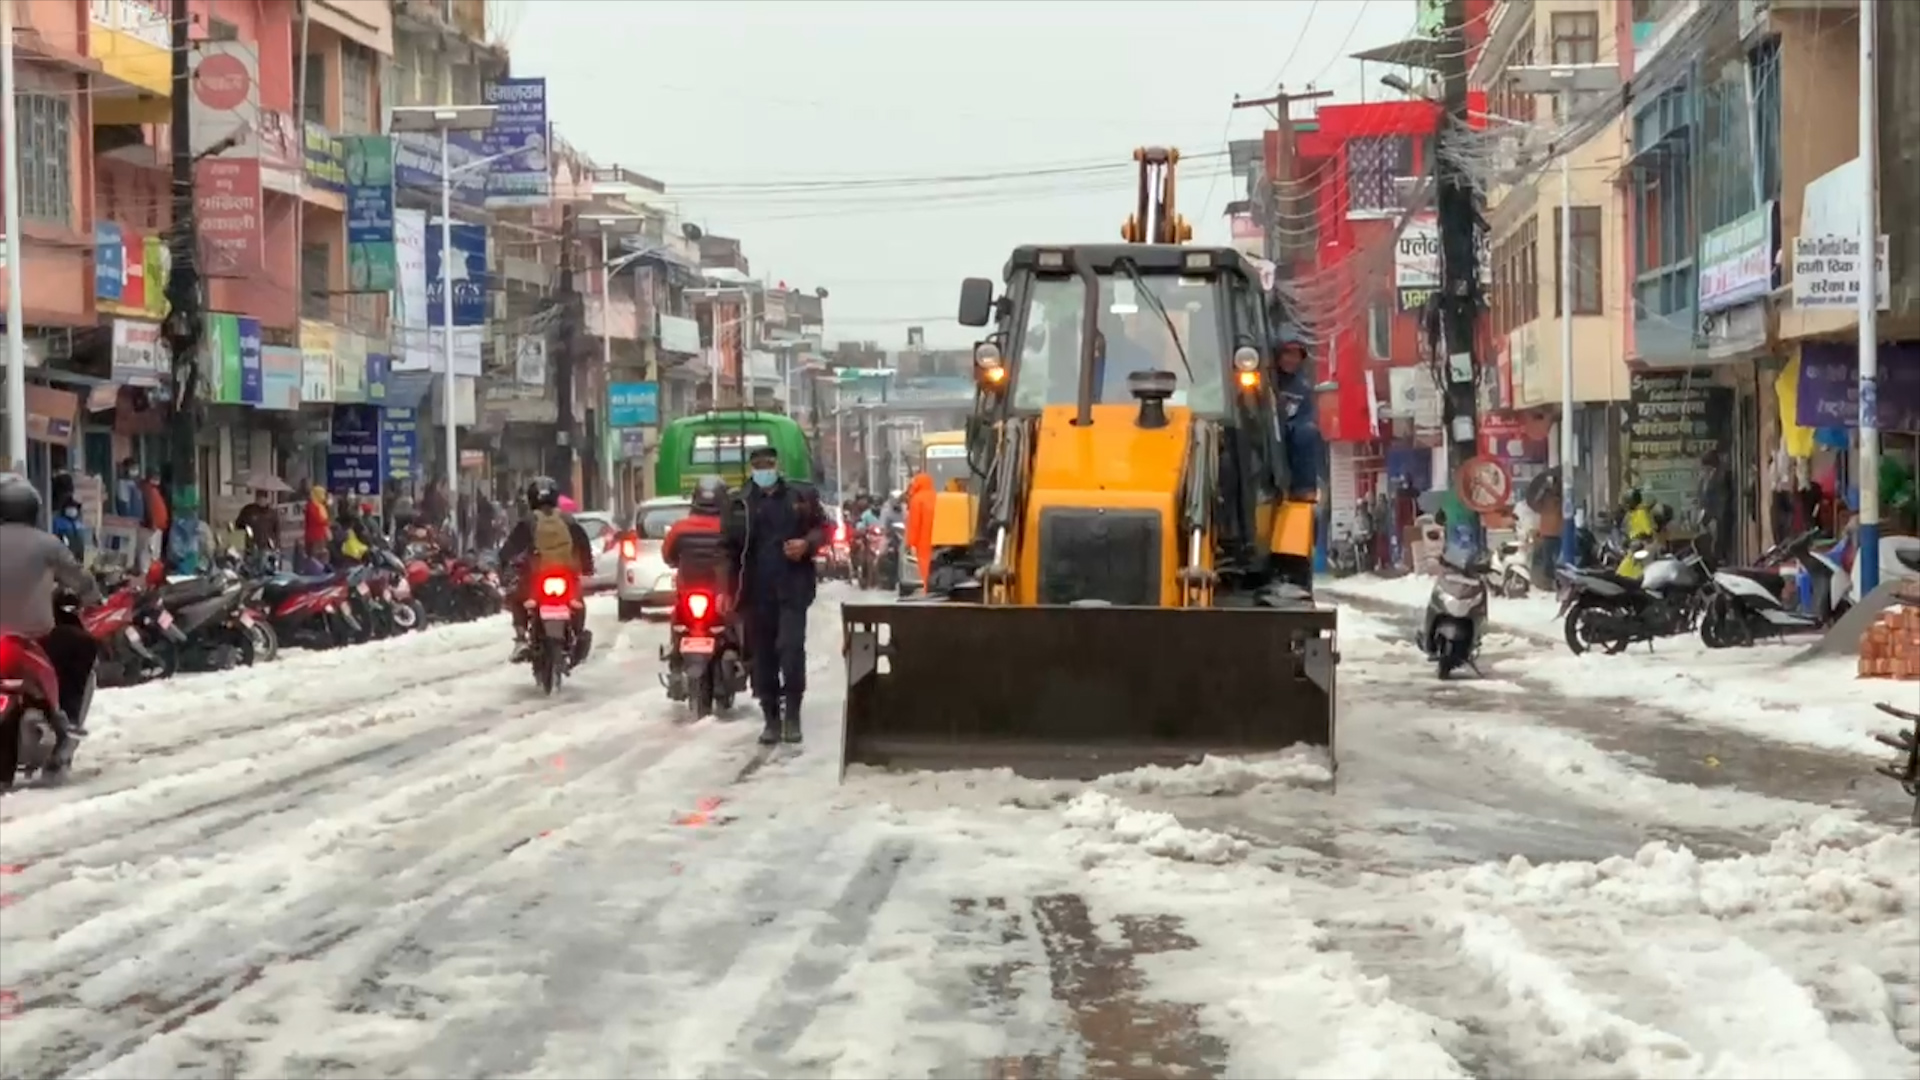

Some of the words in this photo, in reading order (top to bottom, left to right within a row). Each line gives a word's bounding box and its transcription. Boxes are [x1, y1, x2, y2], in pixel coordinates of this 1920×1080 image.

[484, 83, 542, 101] हिमालयन
[1797, 238, 1816, 255] Smile
[1818, 238, 1841, 255] Dental
[1797, 259, 1824, 274] हामी
[427, 282, 481, 295] KIG'S
